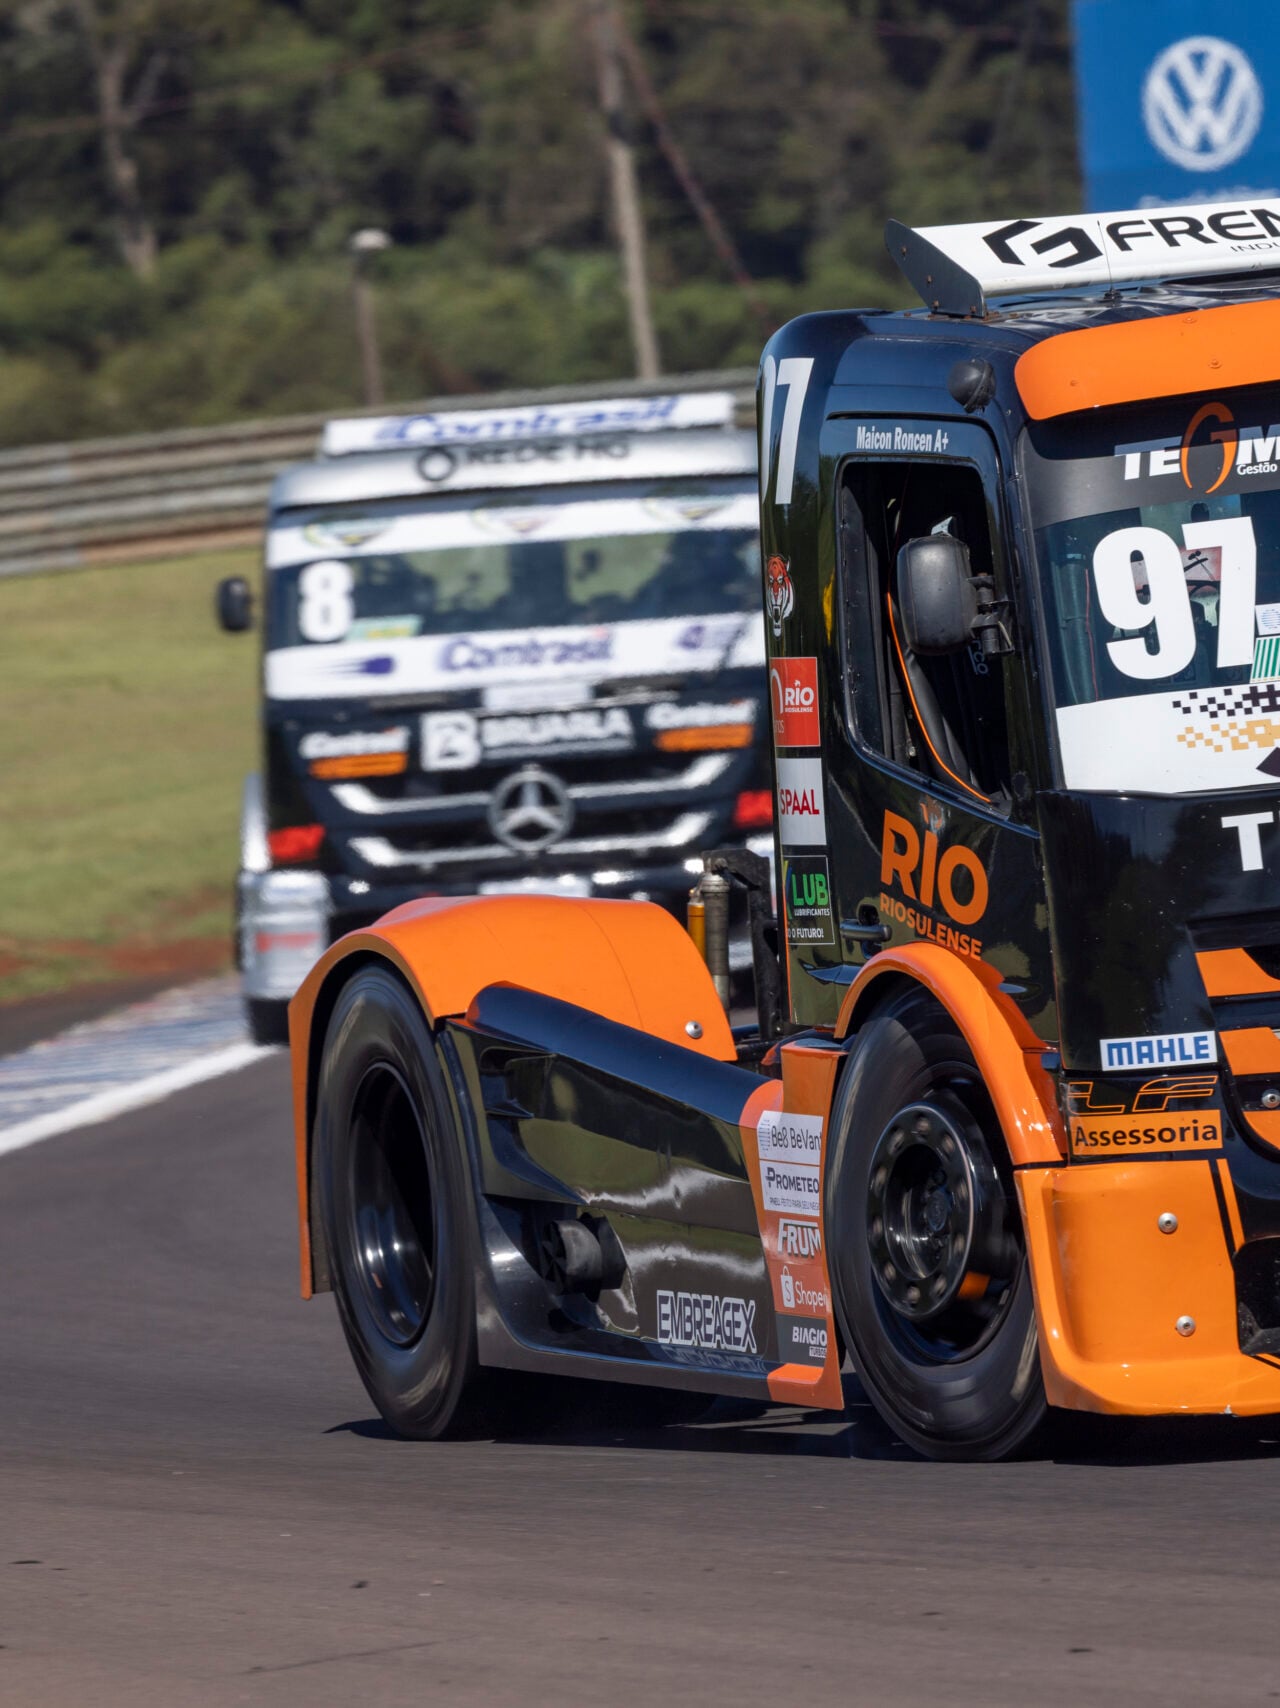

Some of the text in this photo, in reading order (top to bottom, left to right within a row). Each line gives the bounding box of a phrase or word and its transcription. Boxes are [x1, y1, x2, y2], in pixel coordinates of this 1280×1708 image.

[856, 425, 949, 452] Maicon Roncen A+
[1237, 461, 1278, 476] Gestão
[299, 560, 355, 642] 8
[1093, 516, 1258, 680] 97
[780, 788, 820, 815] SPAAL
[880, 892, 983, 960] RIOSULENSE
[1107, 1035, 1210, 1067] MAHLE
[771, 1125, 789, 1148] Be8
[1074, 1119, 1218, 1147] Assessoria
[765, 1167, 819, 1194] PROMETEO
[778, 1218, 822, 1257] FRUM
[657, 1289, 757, 1353] EMBREAGEX
[792, 1326, 827, 1347] BIAGIO
